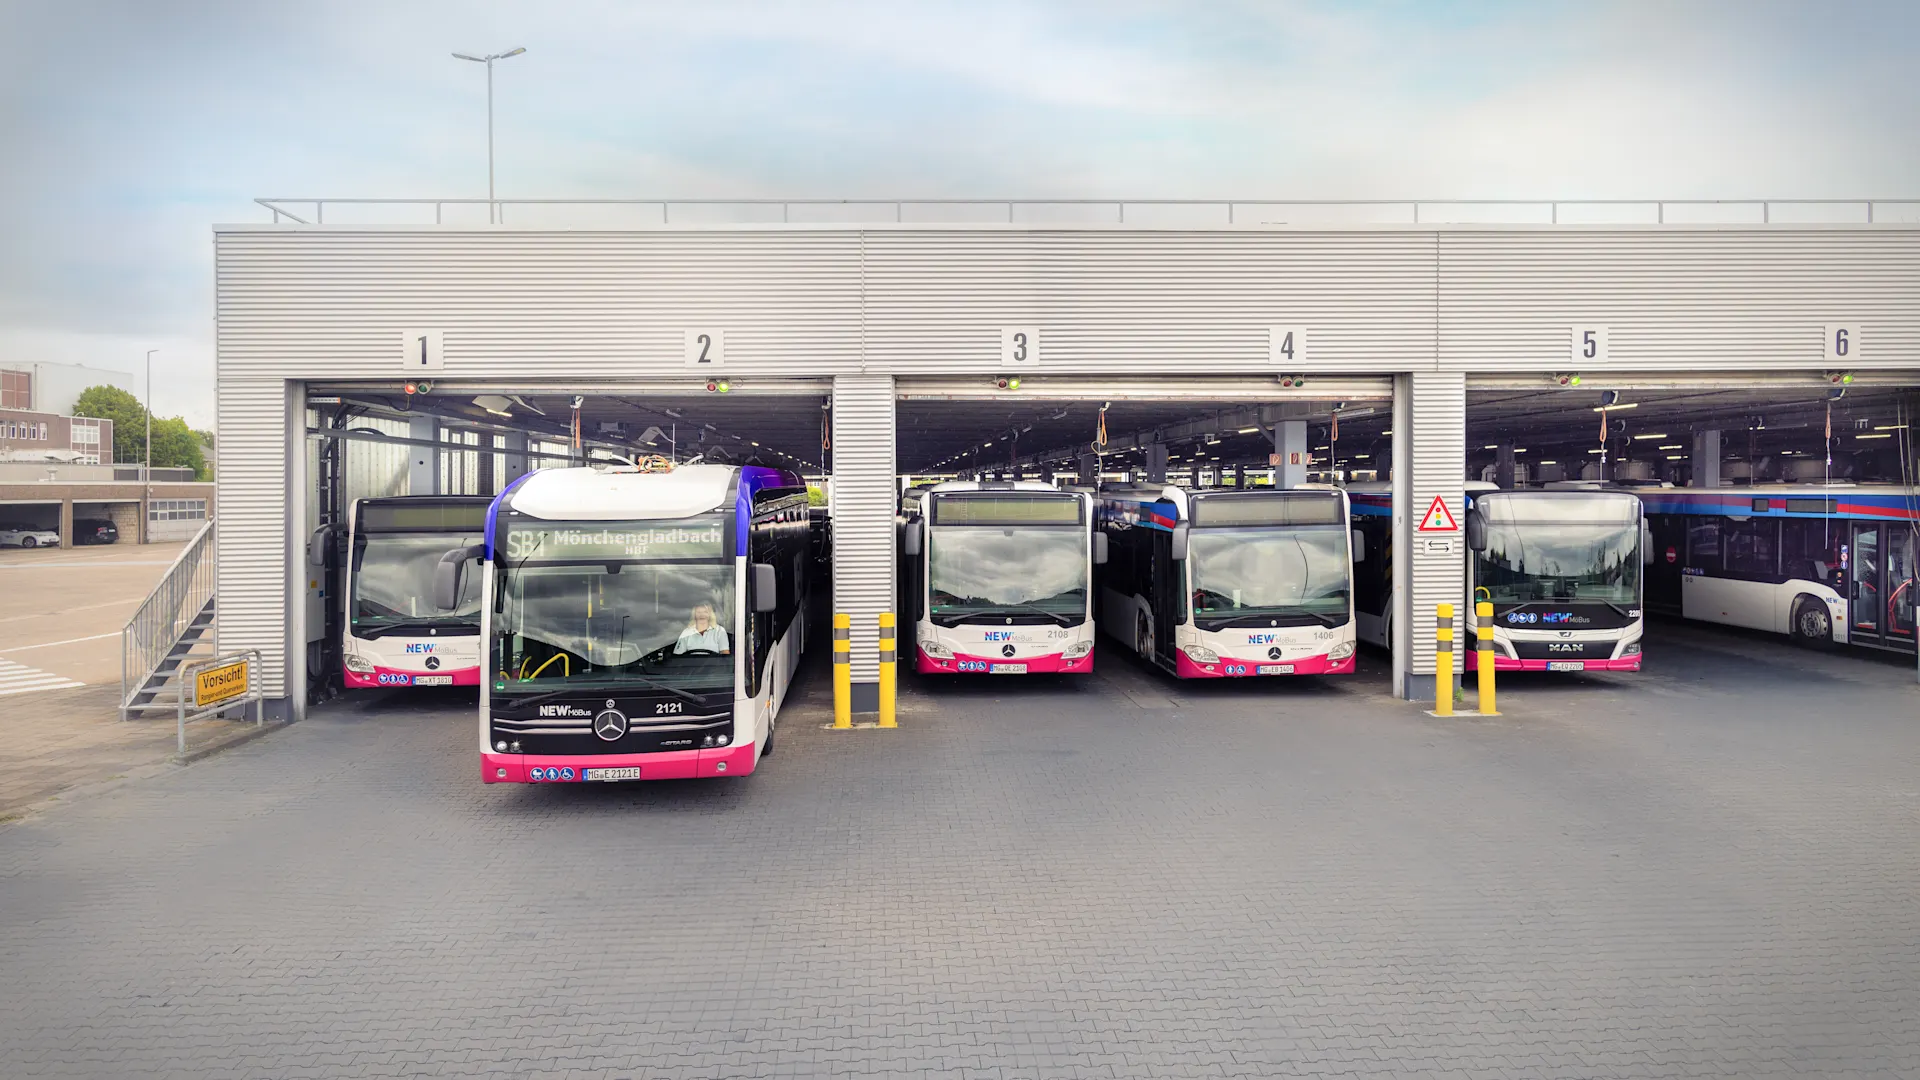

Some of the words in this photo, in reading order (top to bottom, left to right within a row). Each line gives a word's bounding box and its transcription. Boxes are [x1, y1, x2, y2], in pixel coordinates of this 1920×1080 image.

[1013, 332, 1027, 361] 3
[1280, 331, 1294, 360] 4
[1583, 330, 1596, 359] 5
[1835, 328, 1849, 356] 6
[417, 335, 427, 365] 1
[697, 333, 711, 363] 2
[506, 530, 545, 558] SB1
[553, 528, 722, 546] Mönchengladbach
[1543, 612, 1570, 623] NEW
[984, 631, 1012, 641] NEW
[1047, 630, 1069, 639] 2108
[1248, 634, 1275, 644] NEW
[1313, 631, 1334, 640] 1406
[406, 643, 435, 653] NEW
[1548, 643, 1584, 652] MAN
[203, 665, 243, 689] Vorsicht!
[540, 705, 570, 716] NEW
[655, 702, 683, 714] 2121
[588, 770, 599, 779] MG
